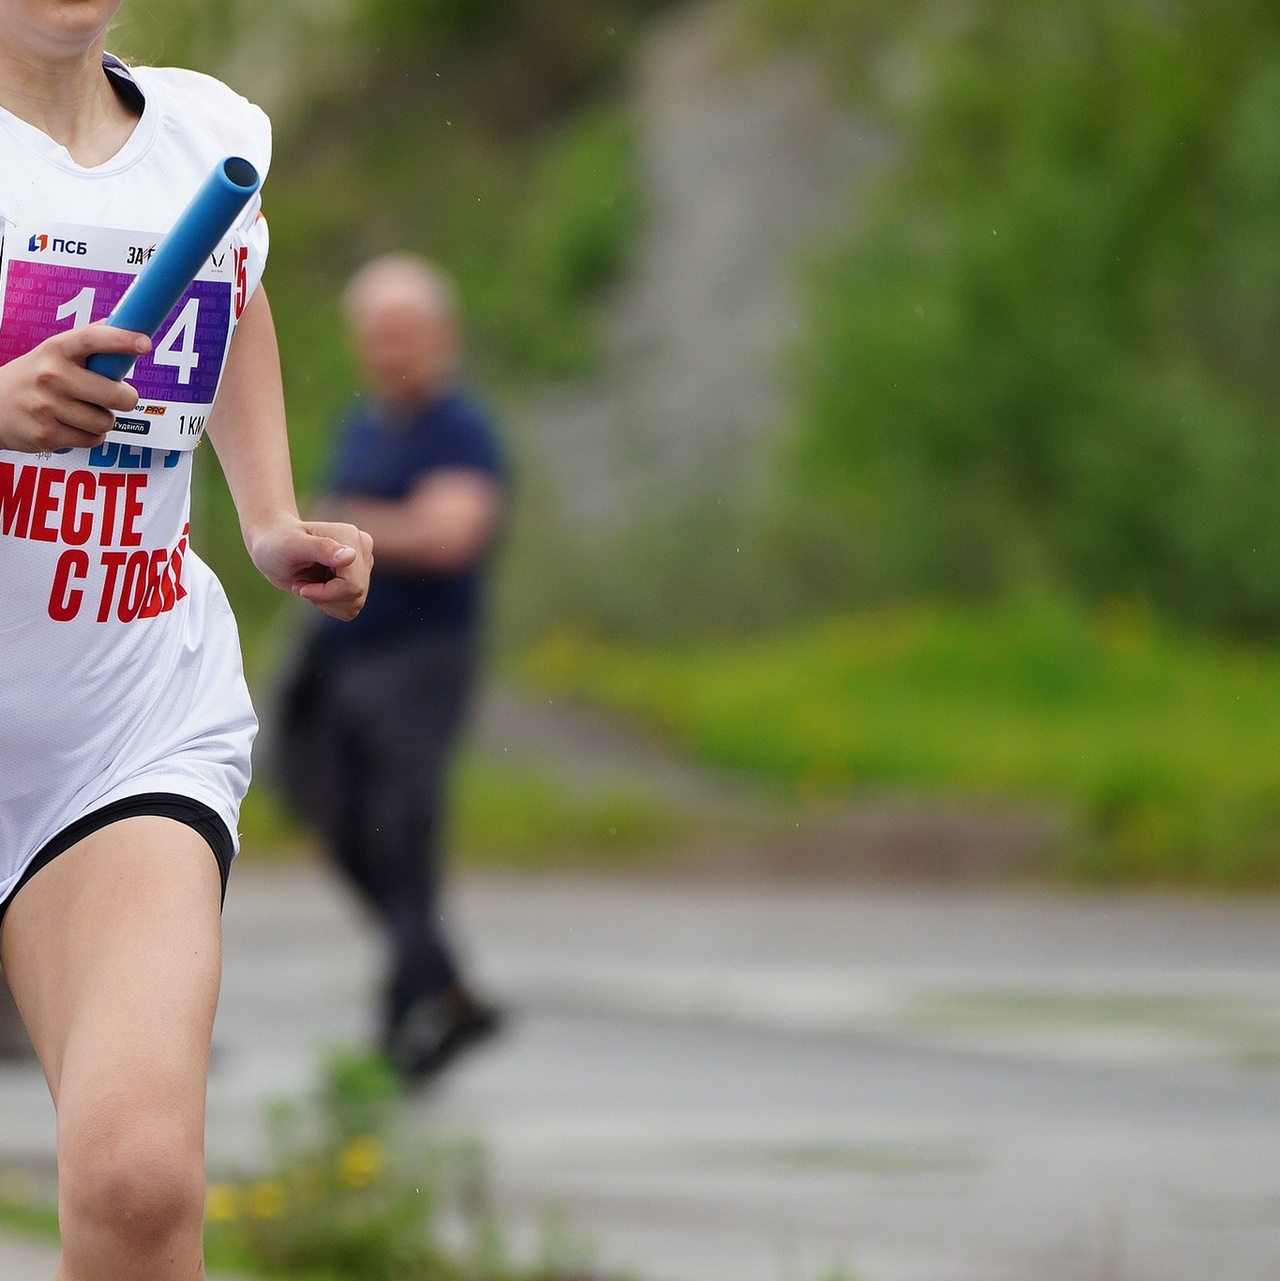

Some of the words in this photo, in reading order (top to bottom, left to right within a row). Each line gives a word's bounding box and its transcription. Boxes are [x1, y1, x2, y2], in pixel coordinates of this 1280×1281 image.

[52, 238, 87, 255] ПСБ
[56, 287, 200, 385] 14
[145, 405, 166, 415] PRO
[179, 415, 186, 435] 1
[47, 549, 89, 622] С
